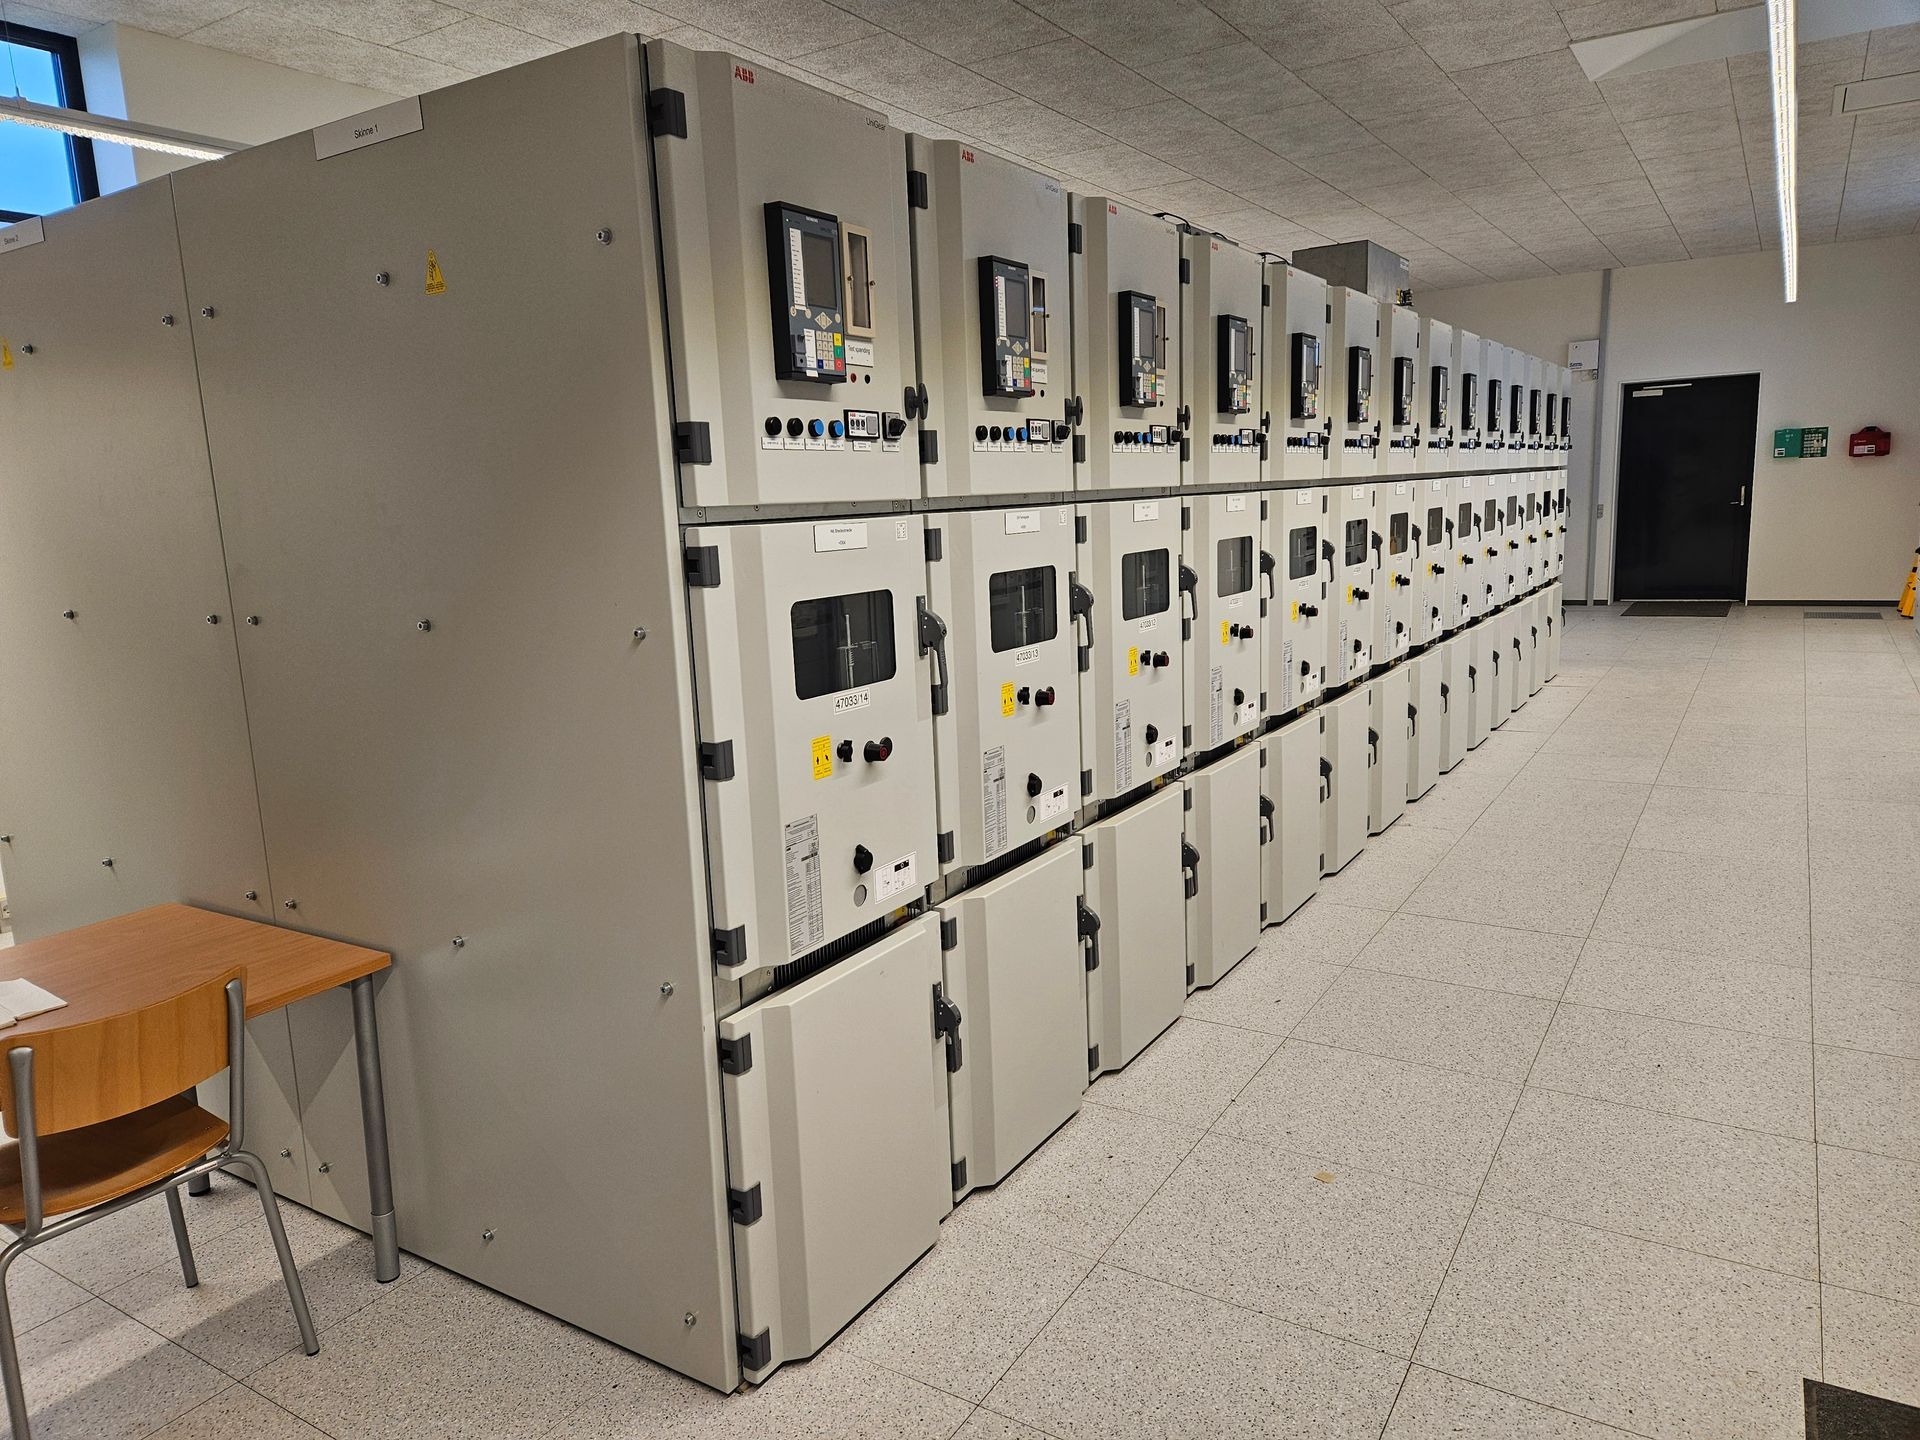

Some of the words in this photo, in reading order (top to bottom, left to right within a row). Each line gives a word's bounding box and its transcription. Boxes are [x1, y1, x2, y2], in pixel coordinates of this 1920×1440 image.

[735, 65, 754, 84] ABB
[865, 116, 886, 131] UniGear
[354, 126, 374, 139] Skinne
[374, 124, 379, 133] 1
[961, 149, 975, 163] ABB
[1108, 203, 1118, 215] ABB
[1016, 648, 1039, 663] 47033/13
[835, 692, 869, 709] 47033/14
